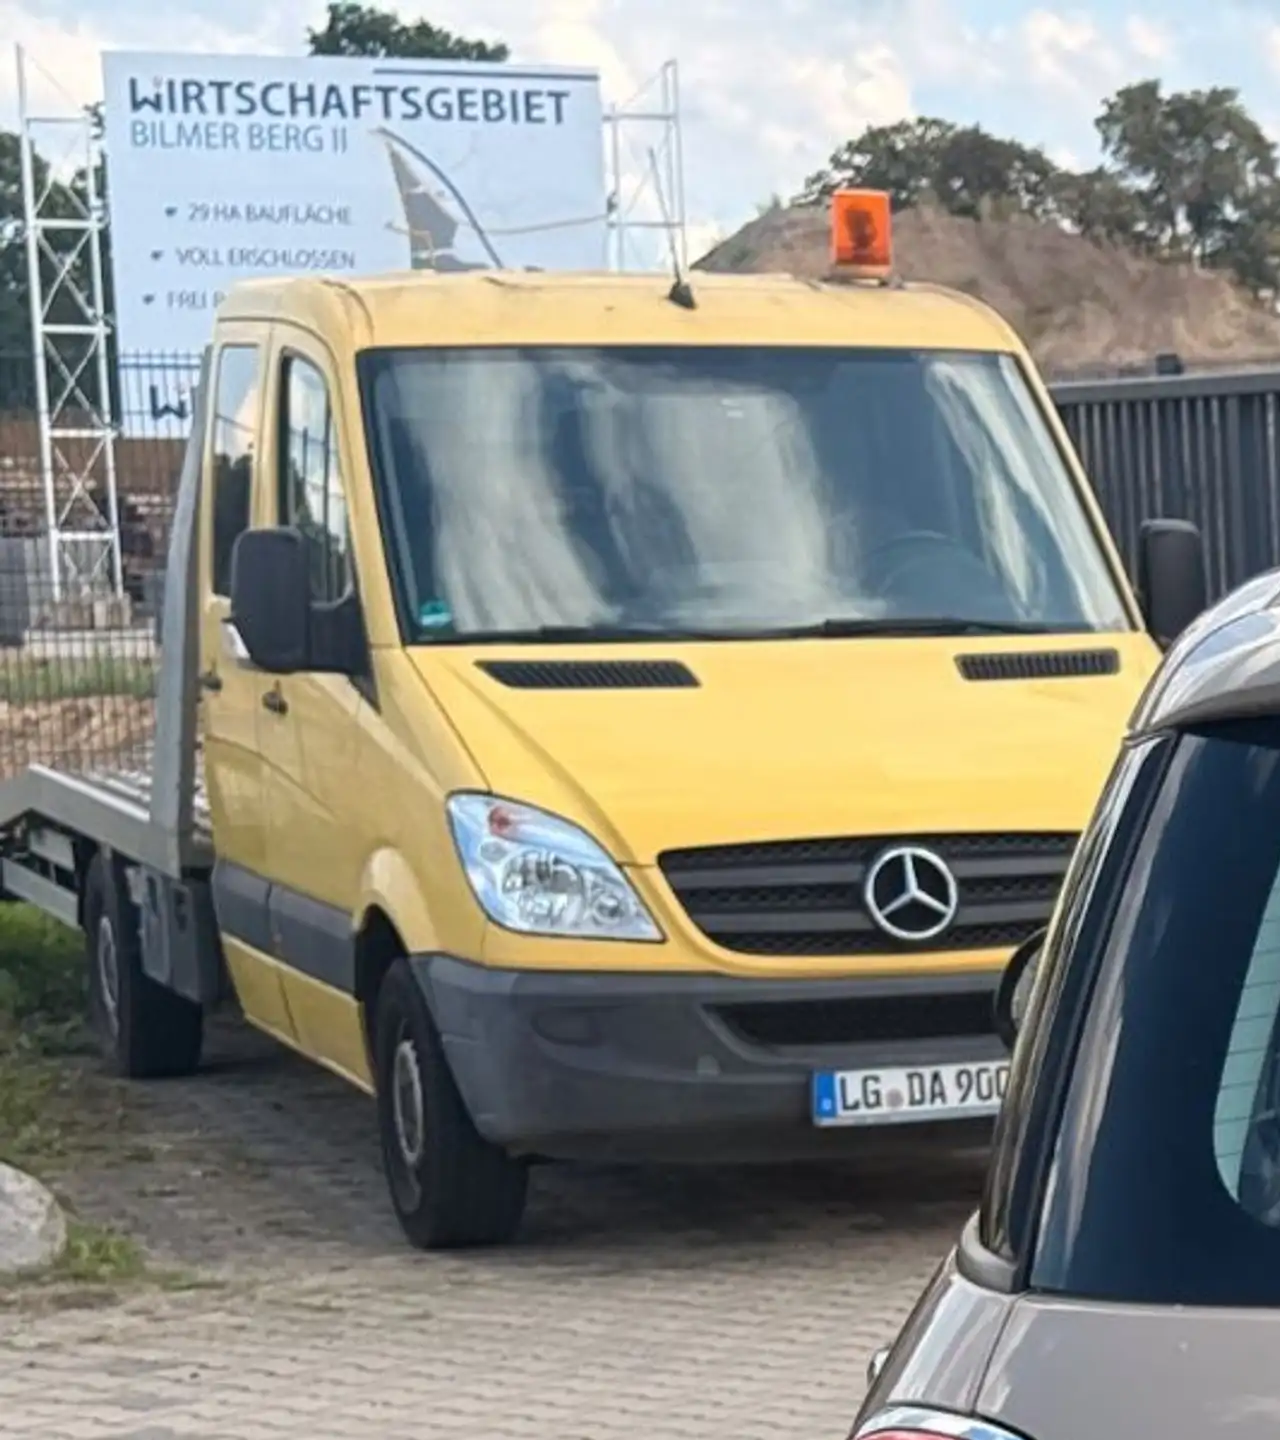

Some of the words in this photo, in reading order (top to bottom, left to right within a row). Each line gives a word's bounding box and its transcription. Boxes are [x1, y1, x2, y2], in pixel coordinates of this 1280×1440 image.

[129, 77, 571, 125] WIRTSCHAFTSGEBIET
[131, 120, 239, 149] BILMER
[248, 122, 323, 151] BERG
[332, 127, 348, 153] II
[188, 202, 210, 221] 29
[213, 204, 241, 222] HA
[175, 247, 223, 268] VOLL
[228, 248, 356, 269] ERSCHLOSSEN
[166, 290, 207, 310] FREI
[840, 1075, 882, 1111] LG
[906, 1070, 947, 1106] DA
